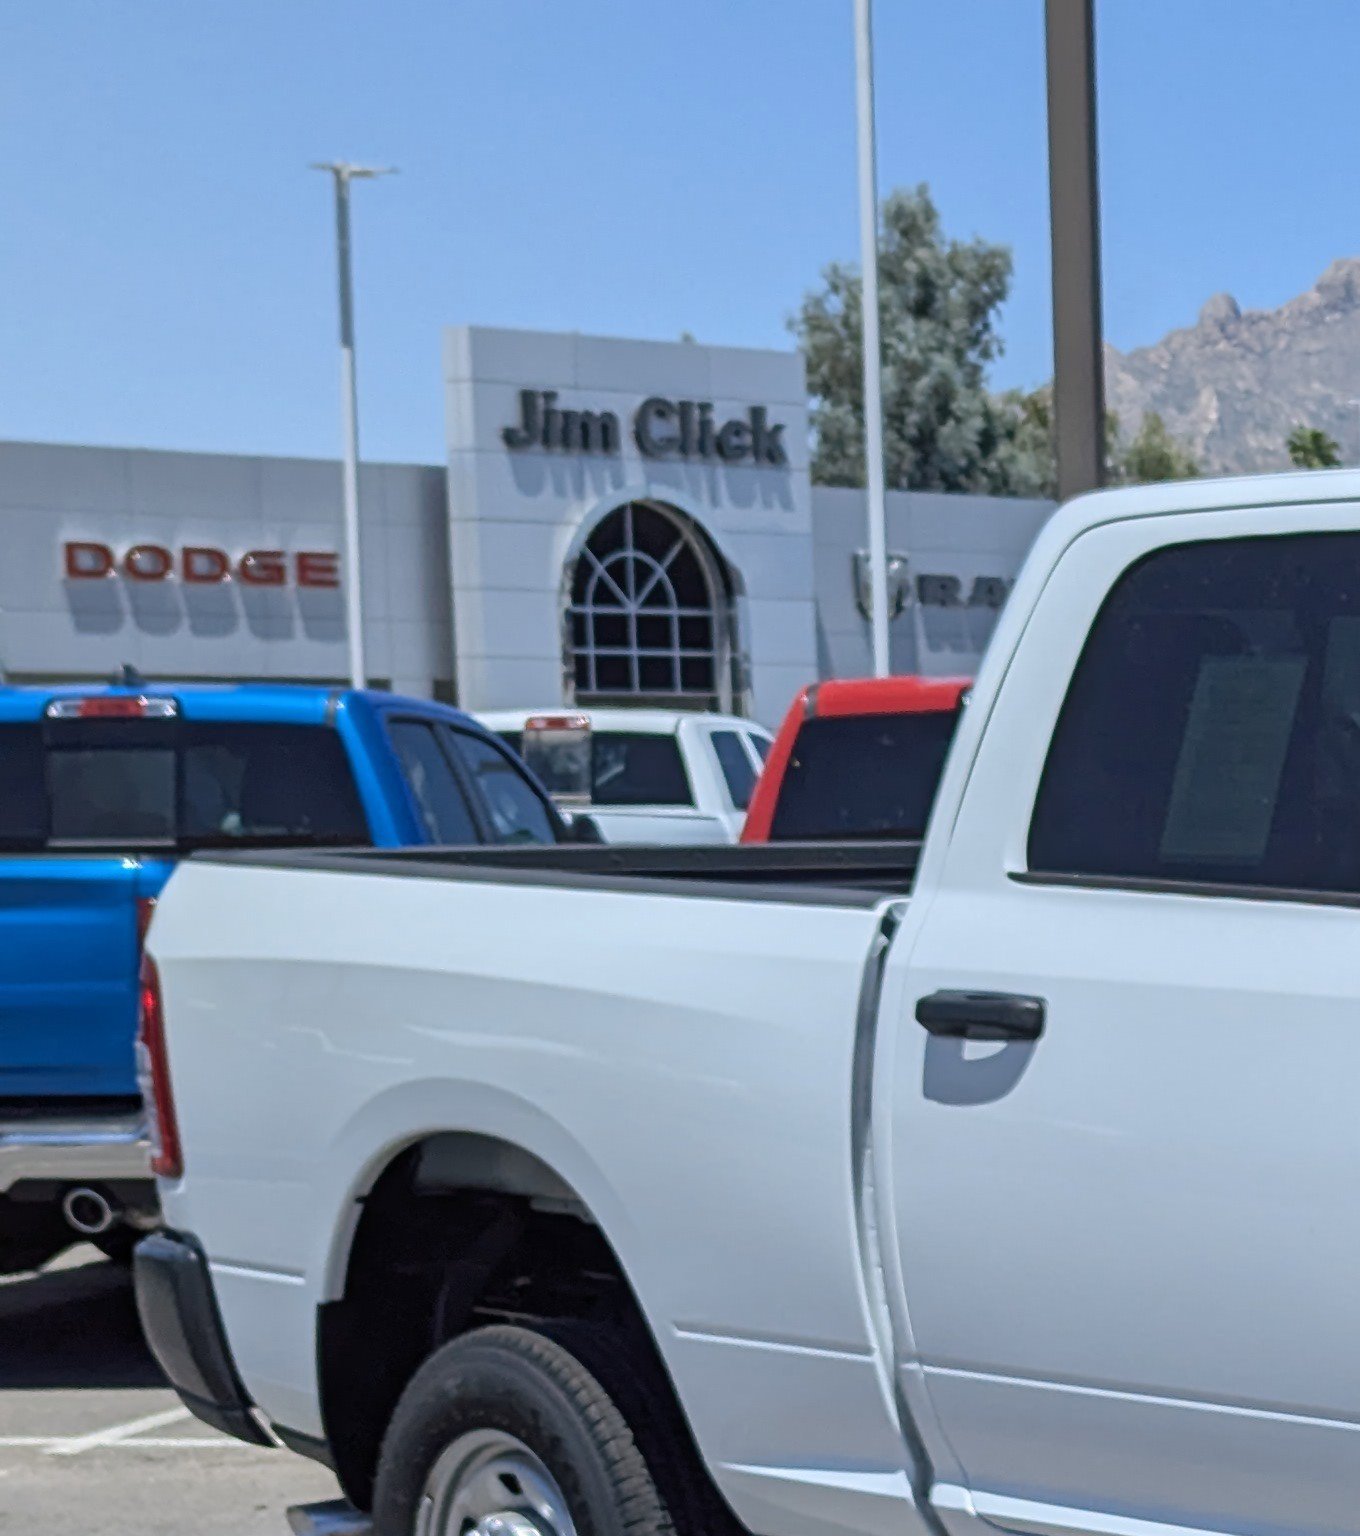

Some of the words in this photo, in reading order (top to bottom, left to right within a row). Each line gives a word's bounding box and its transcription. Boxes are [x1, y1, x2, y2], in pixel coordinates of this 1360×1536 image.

[502, 388, 619, 451] Jim
[634, 397, 788, 466] Click
[64, 542, 341, 588] DODGE
[916, 573, 1017, 608] RA
